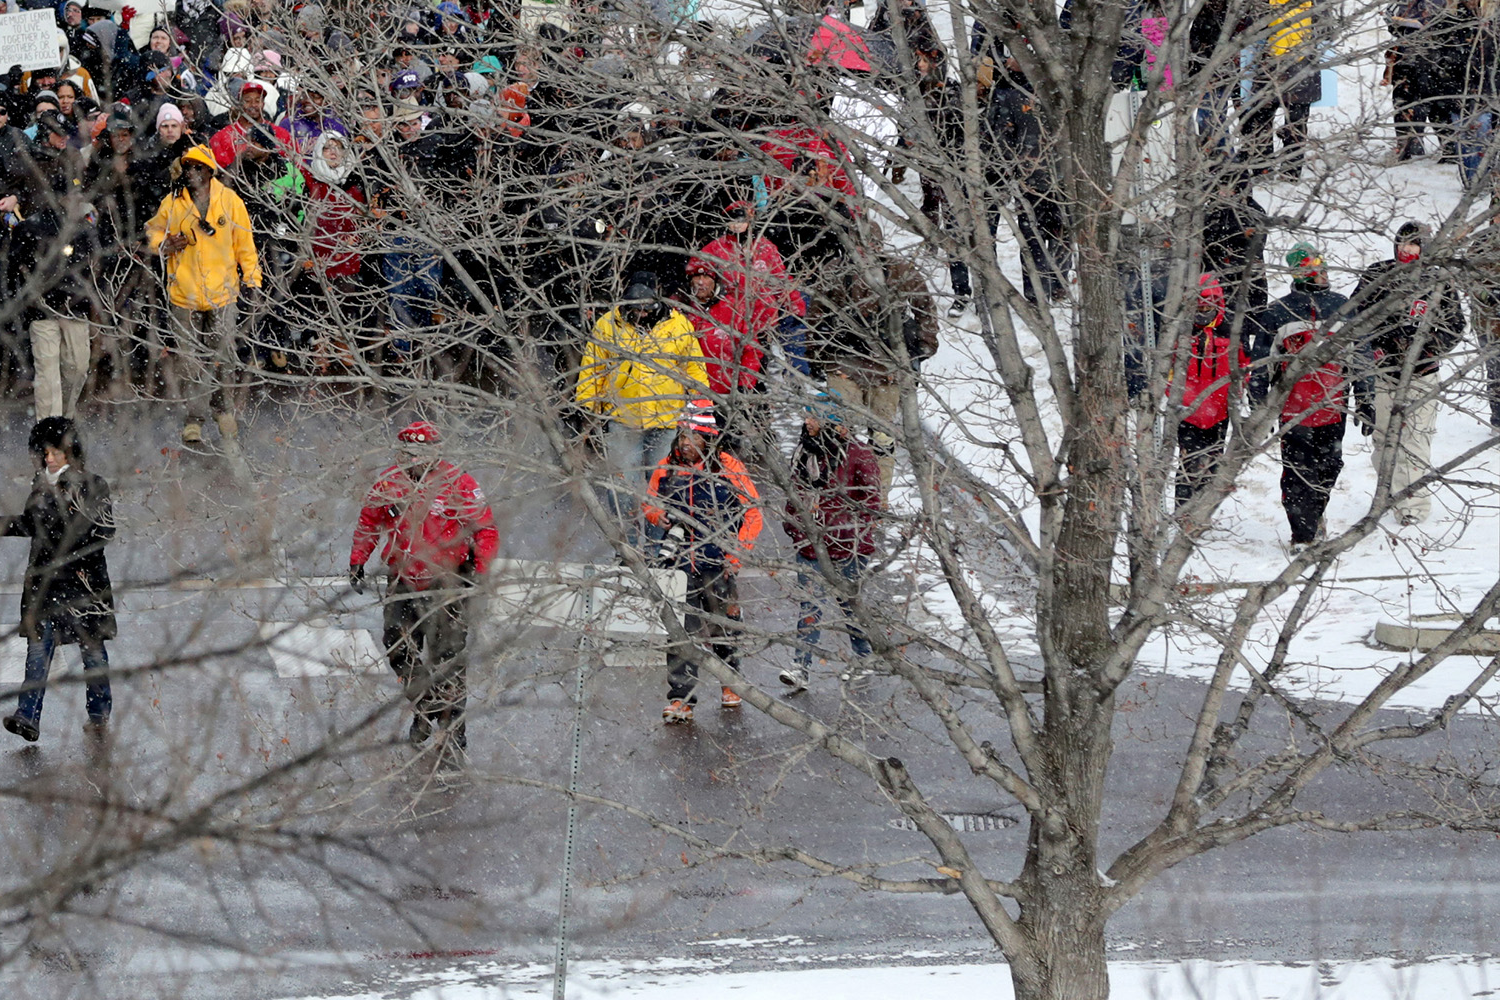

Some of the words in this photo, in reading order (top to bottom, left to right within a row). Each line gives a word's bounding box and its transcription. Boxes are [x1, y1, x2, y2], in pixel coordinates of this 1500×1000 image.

[9, 14, 27, 25] MUST
[30, 11, 52, 22] LEARN
[13, 25, 21, 34] TO
[24, 22, 41, 33] LIVE
[2, 32, 38, 45] TOGETHER
[41, 31, 50, 40] AS
[2, 42, 37, 55] BROTHERS
[40, 40, 50, 50] OR
[0, 53, 23, 64] PERISH
[24, 52, 33, 61] AS
[35, 49, 56, 60] FOOLS
